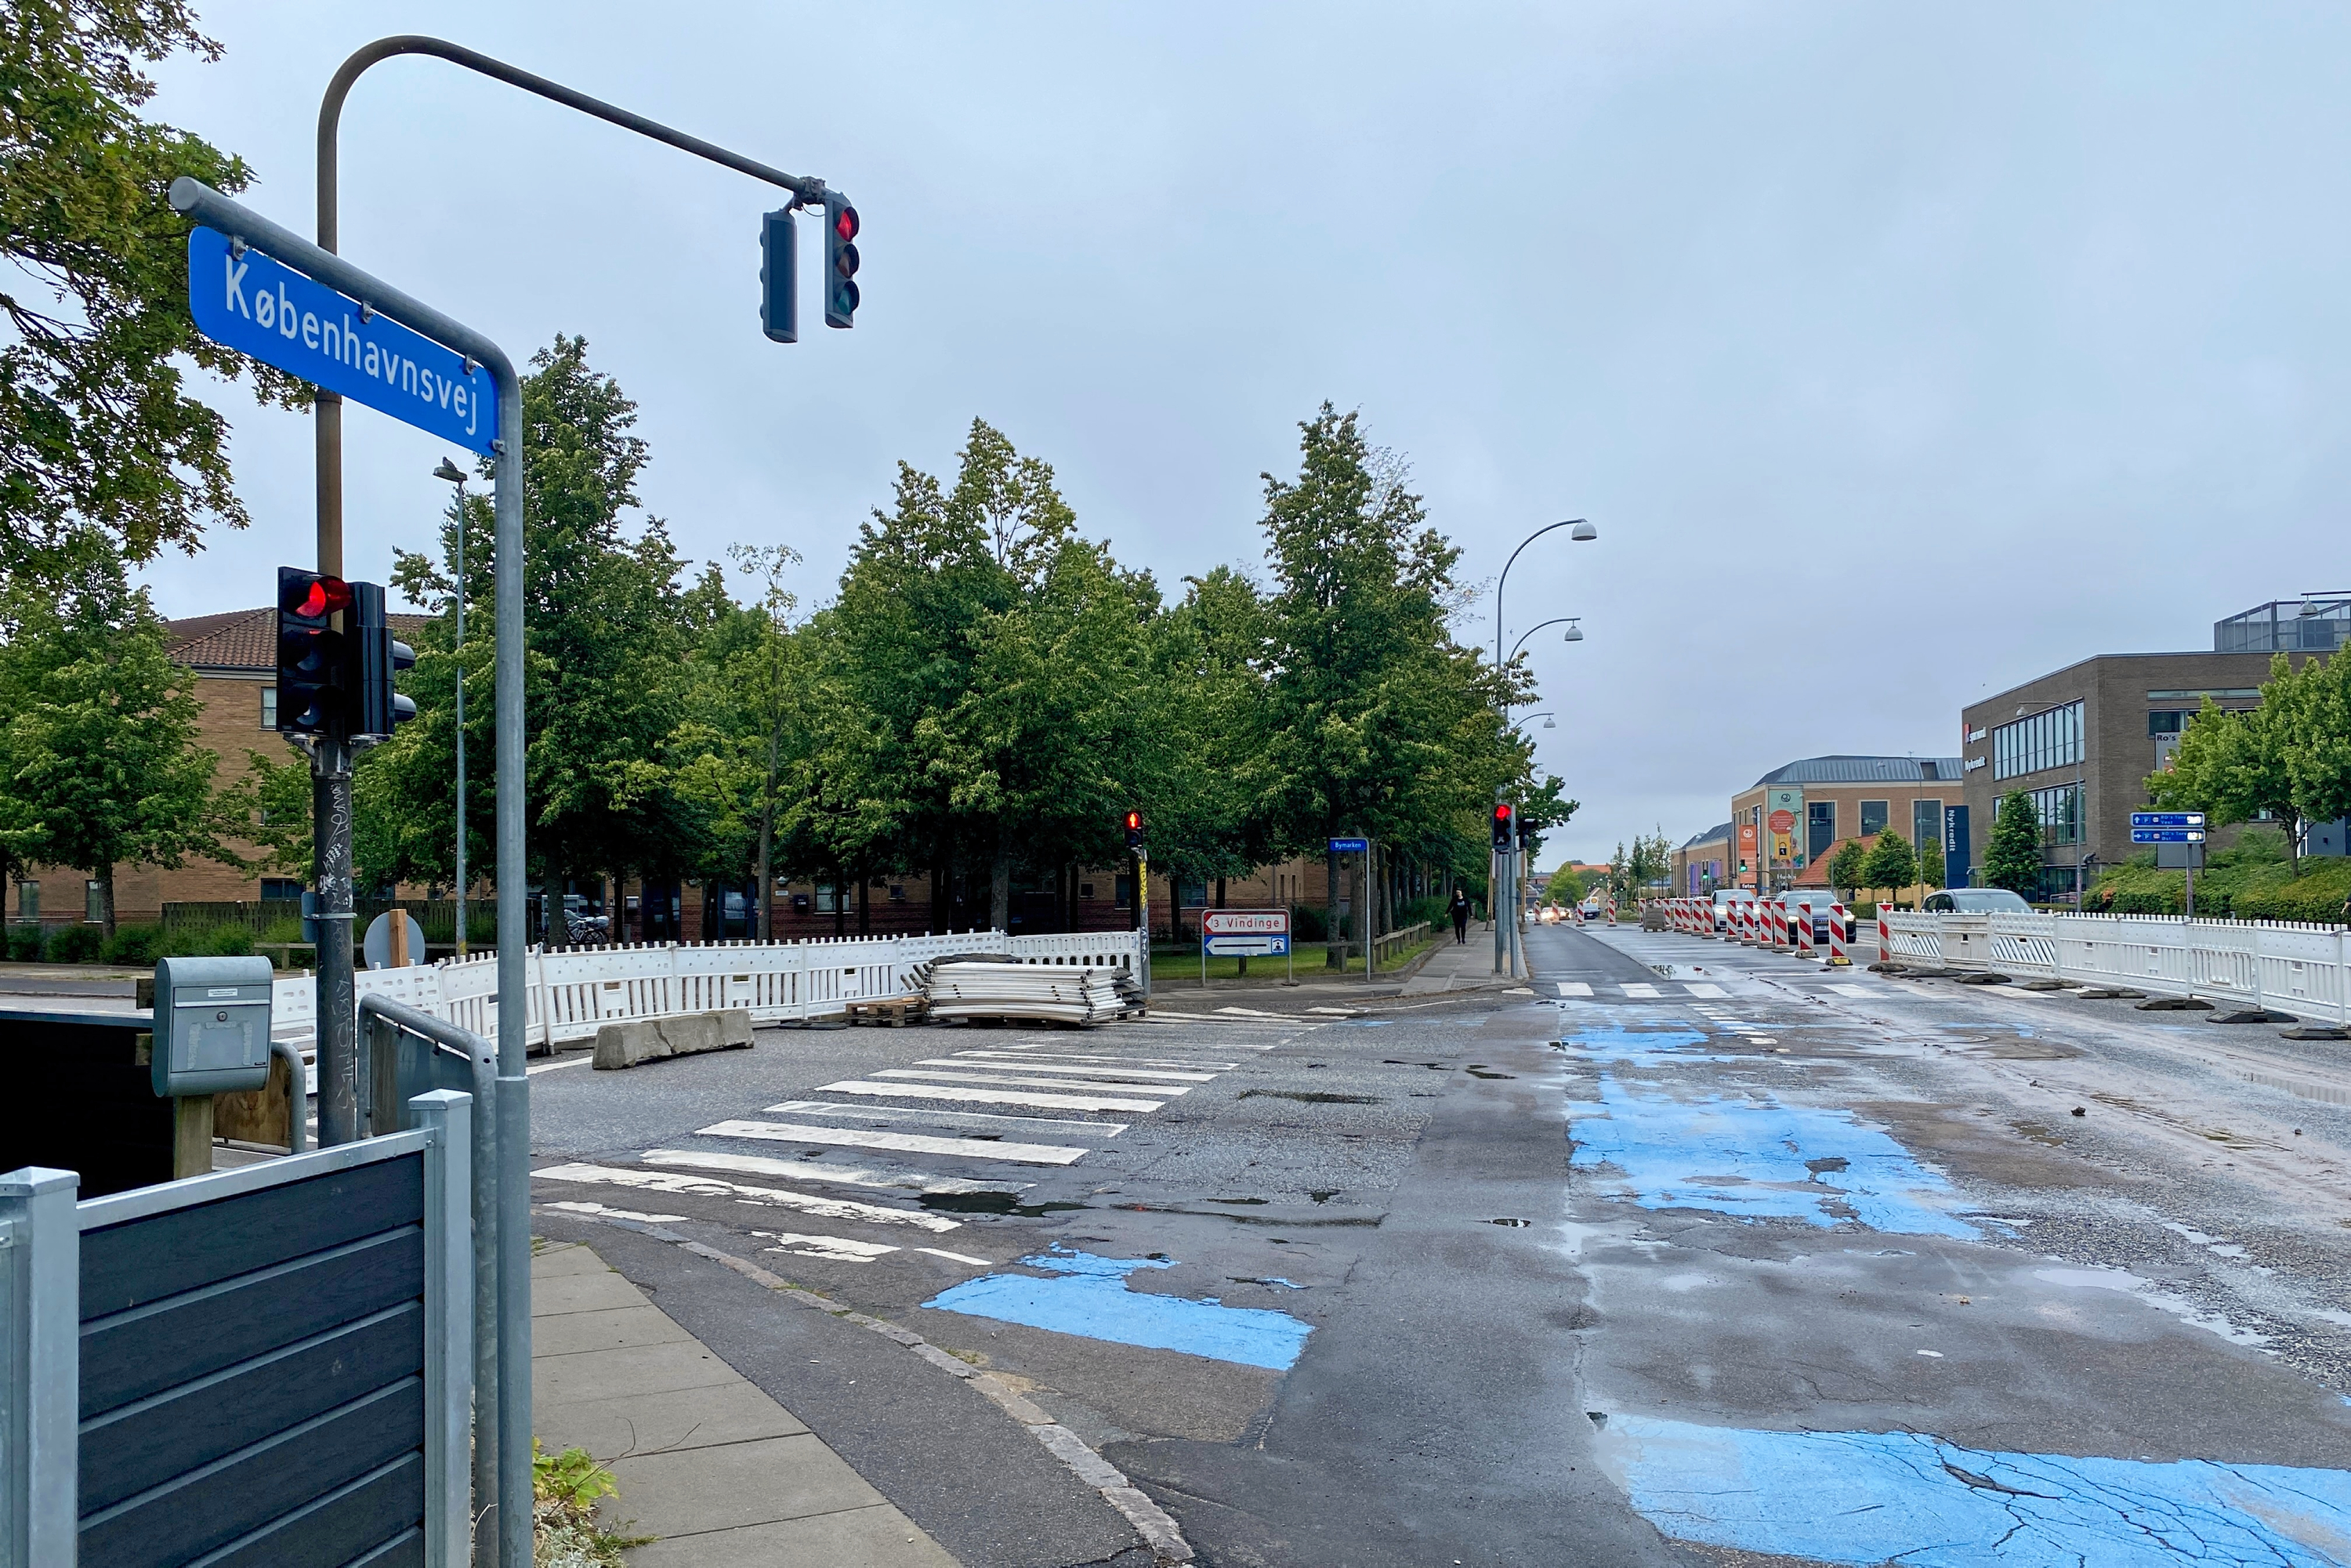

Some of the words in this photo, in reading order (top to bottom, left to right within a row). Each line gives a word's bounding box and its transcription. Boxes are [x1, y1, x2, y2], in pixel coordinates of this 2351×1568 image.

[225, 254, 476, 436] Københavnsvej
[1947, 809, 1956, 852] Nykredit
[1227, 918, 1280, 929] Vindinge
